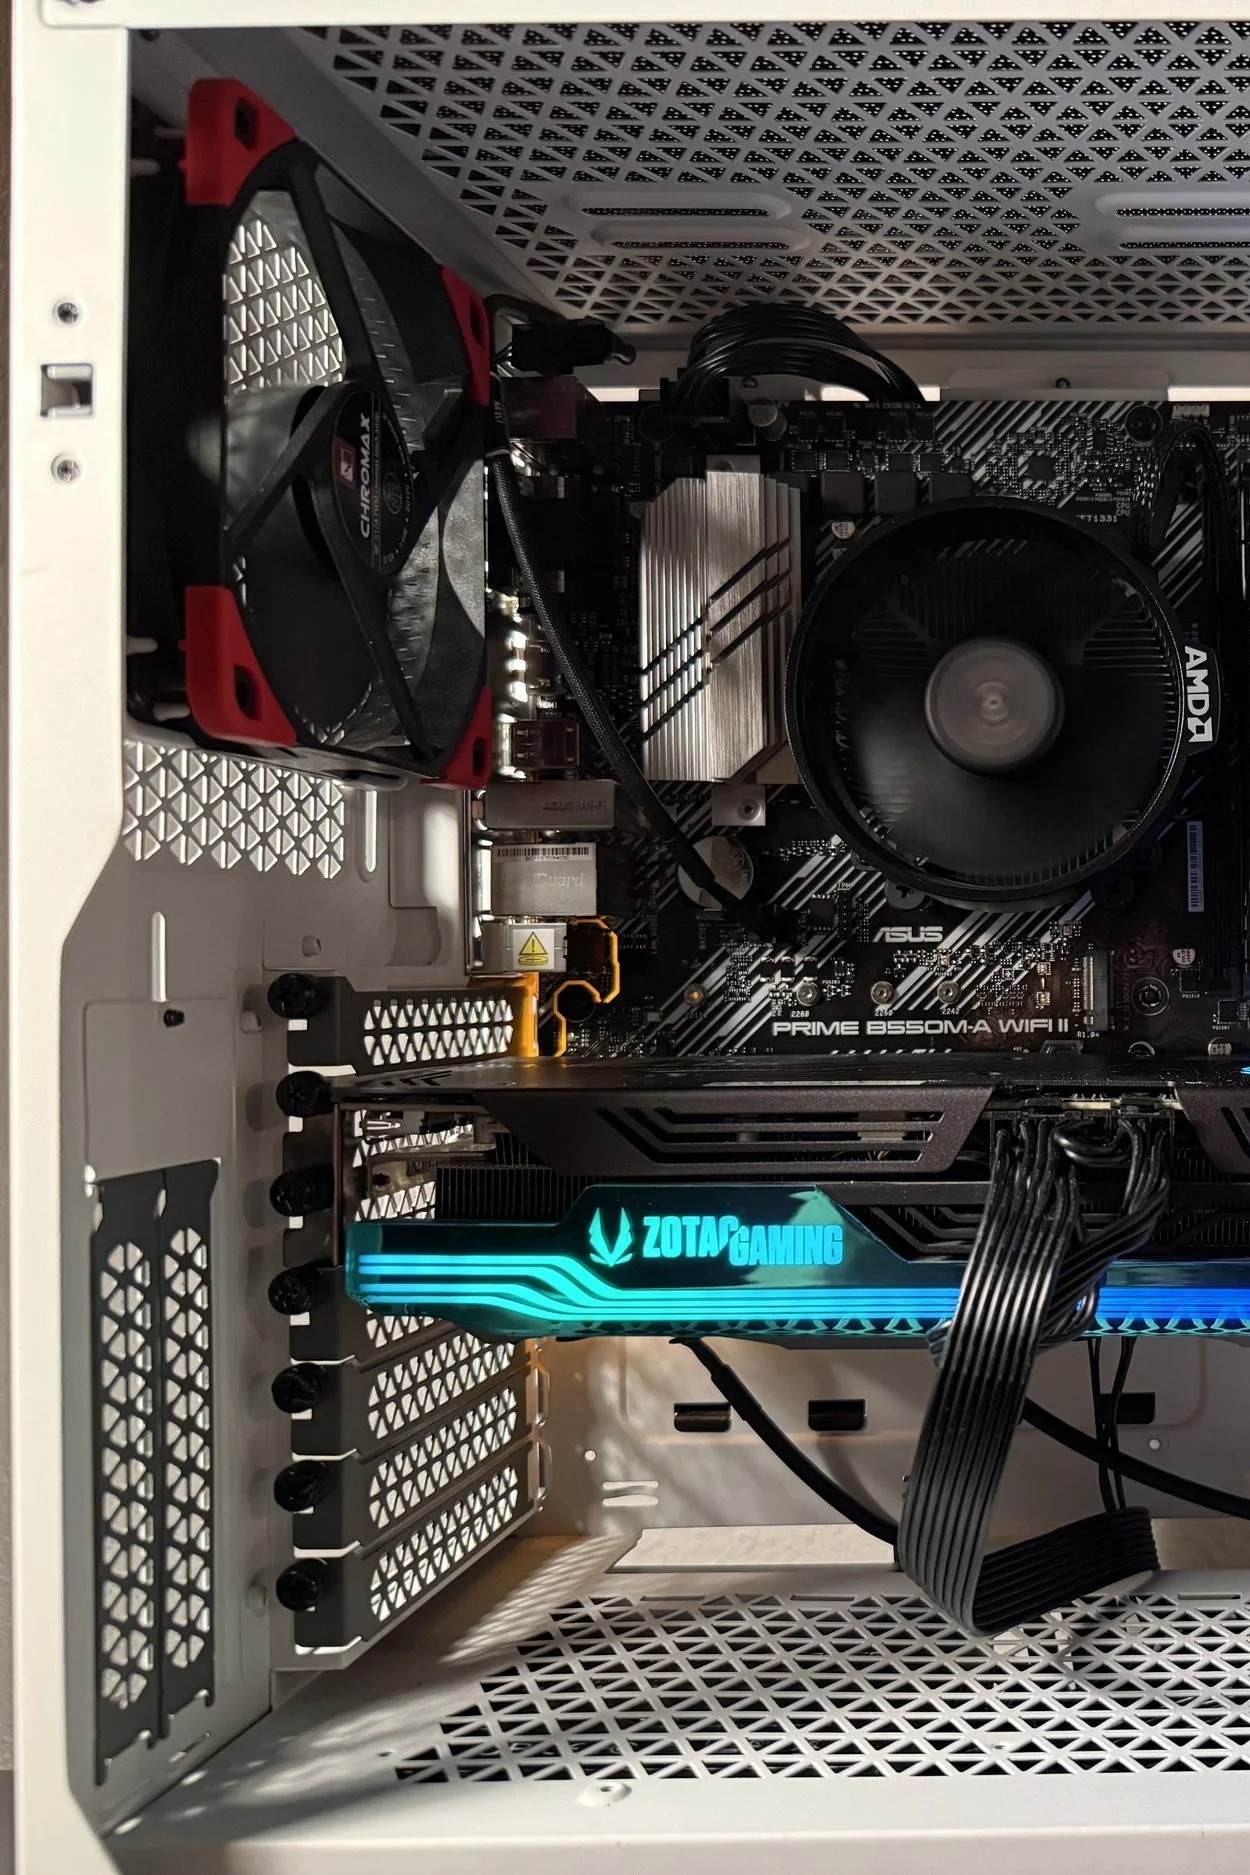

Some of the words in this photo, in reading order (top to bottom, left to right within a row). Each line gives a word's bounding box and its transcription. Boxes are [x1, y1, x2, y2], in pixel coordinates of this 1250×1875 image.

[360, 411, 371, 539] CHROMAX
[1185, 645, 1210, 717] AMD
[539, 700, 558, 709] HDMI
[542, 800, 576, 811] ASUS
[872, 926, 943, 943] ASUS
[791, 1010, 810, 1018] 2280
[772, 1021, 860, 1037] PRIME
[866, 1020, 992, 1036] B550M-A
[998, 1018, 1052, 1035] WIFI
[1054, 1018, 1069, 1034] II
[642, 1215, 739, 1258] ZOTAC
[728, 1224, 844, 1266] GAMING
